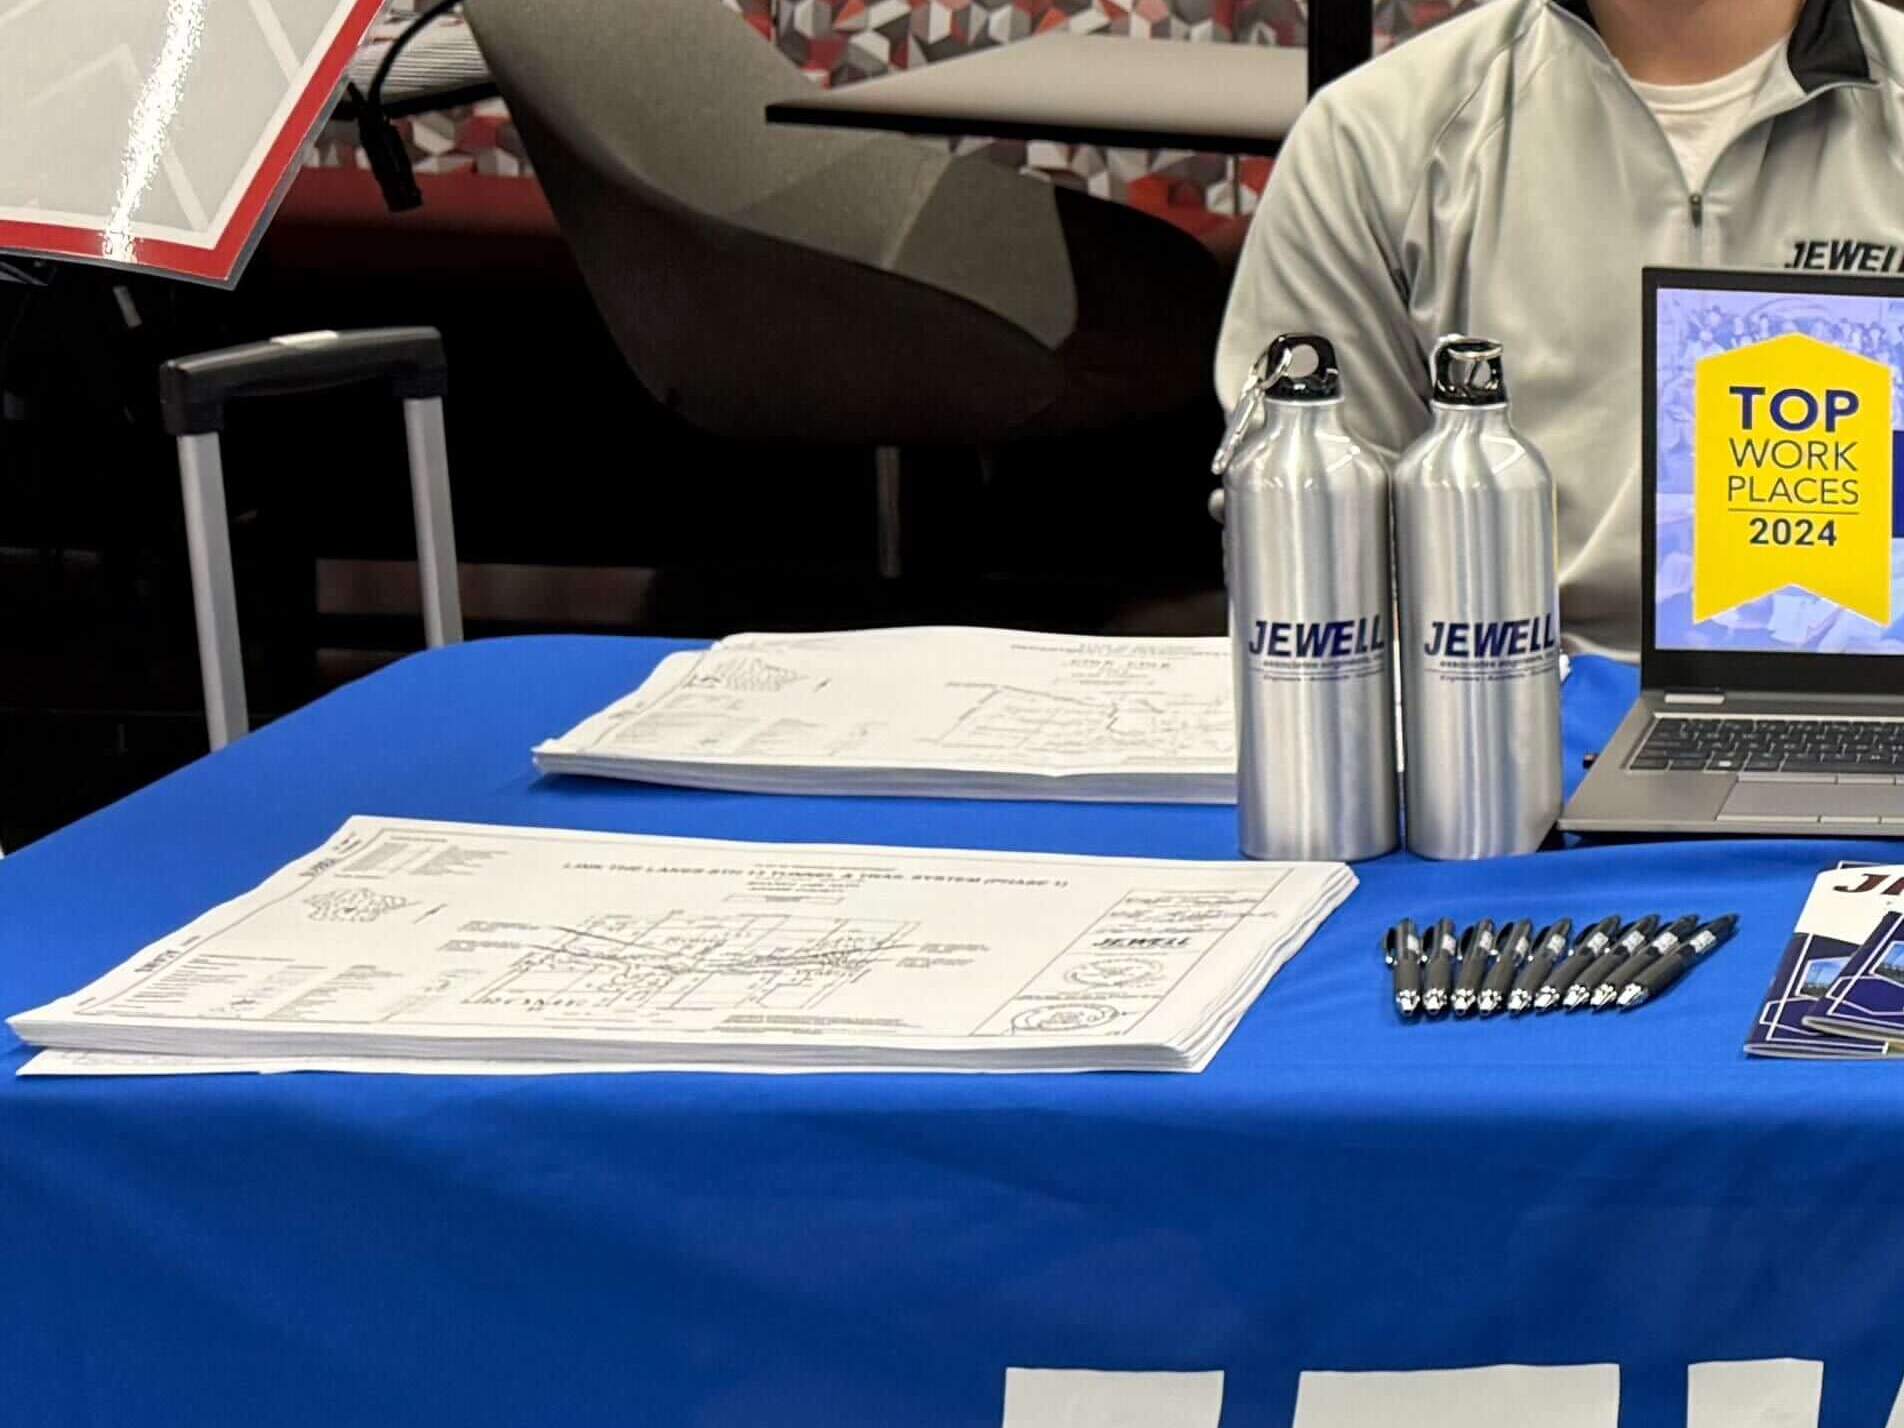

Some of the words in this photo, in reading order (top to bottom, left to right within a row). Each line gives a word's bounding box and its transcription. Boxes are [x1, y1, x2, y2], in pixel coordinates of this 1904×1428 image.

[1728, 385, 1860, 433] TOP
[1728, 437, 1858, 472] WORK
[1727, 475, 1860, 505] PLACES
[1749, 517, 1838, 546] 2024
[1249, 613, 1385, 657] JEWELL
[1424, 612, 1555, 658] JEWELL
